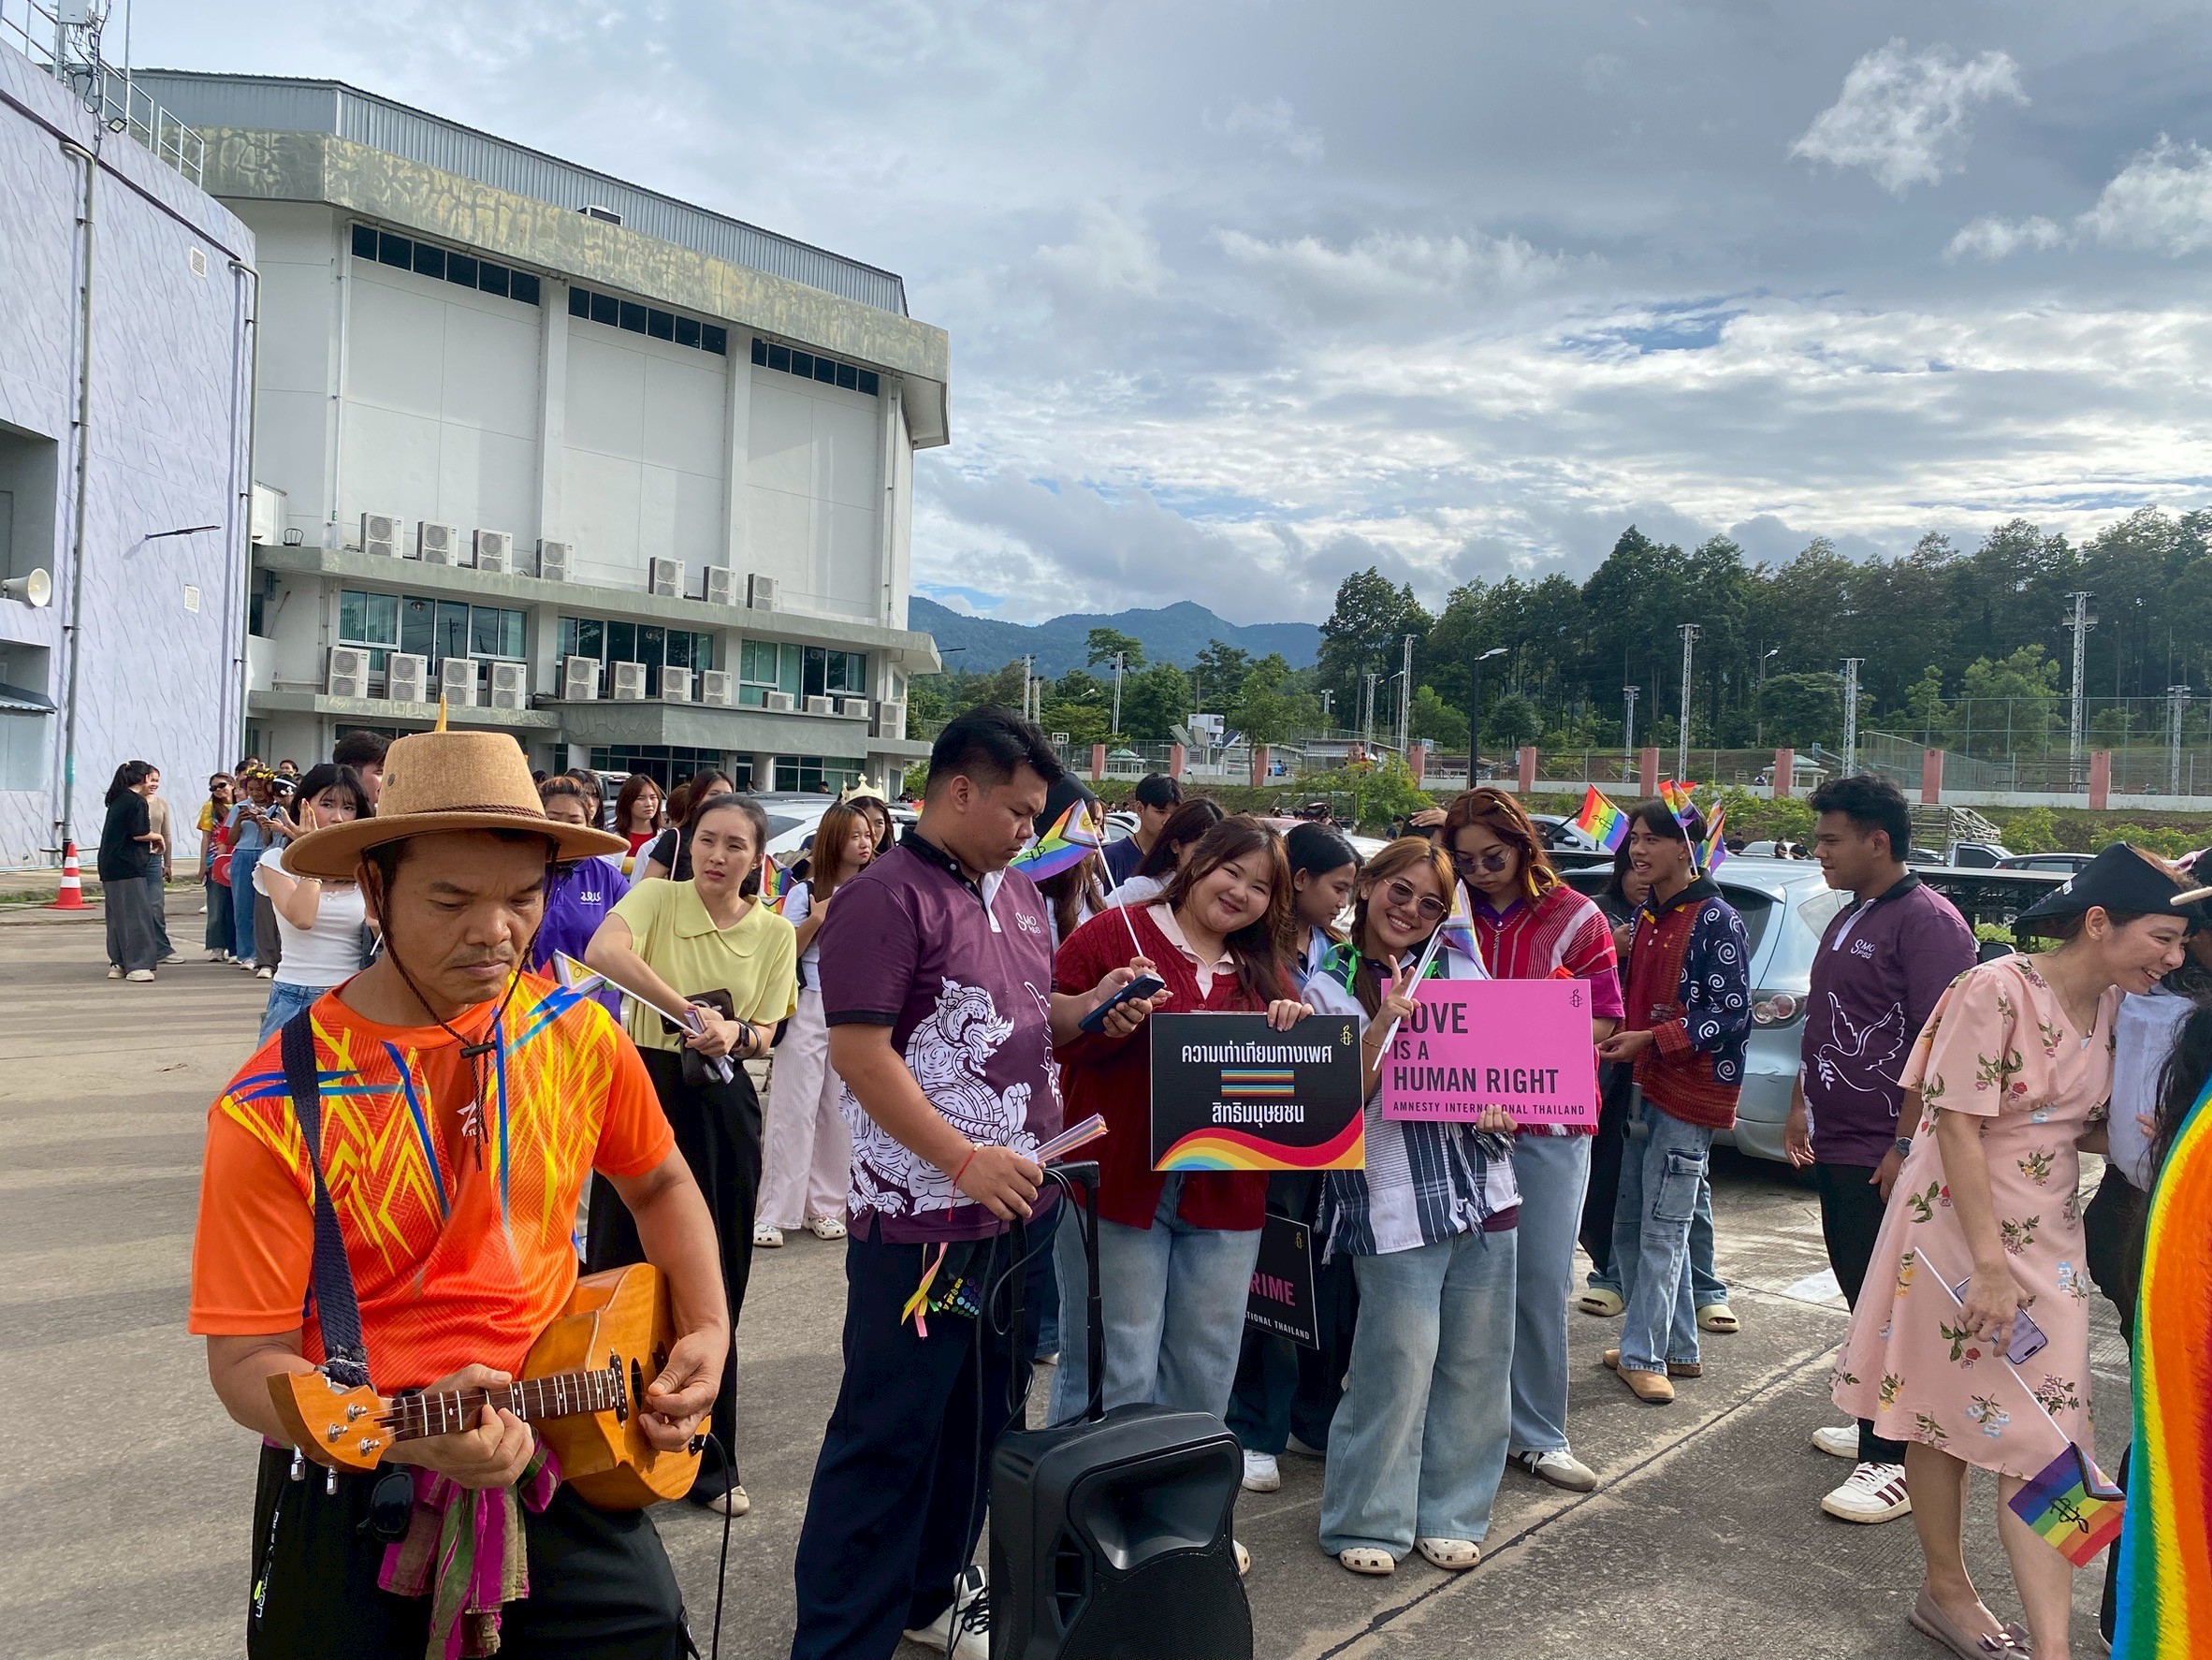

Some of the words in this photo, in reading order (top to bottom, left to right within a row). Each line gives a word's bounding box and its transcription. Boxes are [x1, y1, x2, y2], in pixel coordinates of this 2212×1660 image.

[1851, 939, 1875, 954] SMO
[1181, 1040, 1332, 1063] ความเท่าเทียมทางเพศ
[1393, 1040, 1411, 1060] IS
[1418, 1041, 1430, 1060] A
[1393, 1066, 1477, 1093] HUMAN
[1486, 1068, 1559, 1095] RIGHT
[1212, 1101, 1304, 1129] สิทธิมนุษยชน
[1392, 1101, 1440, 1112] AMNESTY
[1445, 1102, 1528, 1114] INTERNONAL
[1533, 1104, 1585, 1115] THAILAND
[1250, 1271, 1296, 1306] RIME
[1244, 1311, 1272, 1327] TIONAL
[1273, 1320, 1310, 1340] THAILAND
